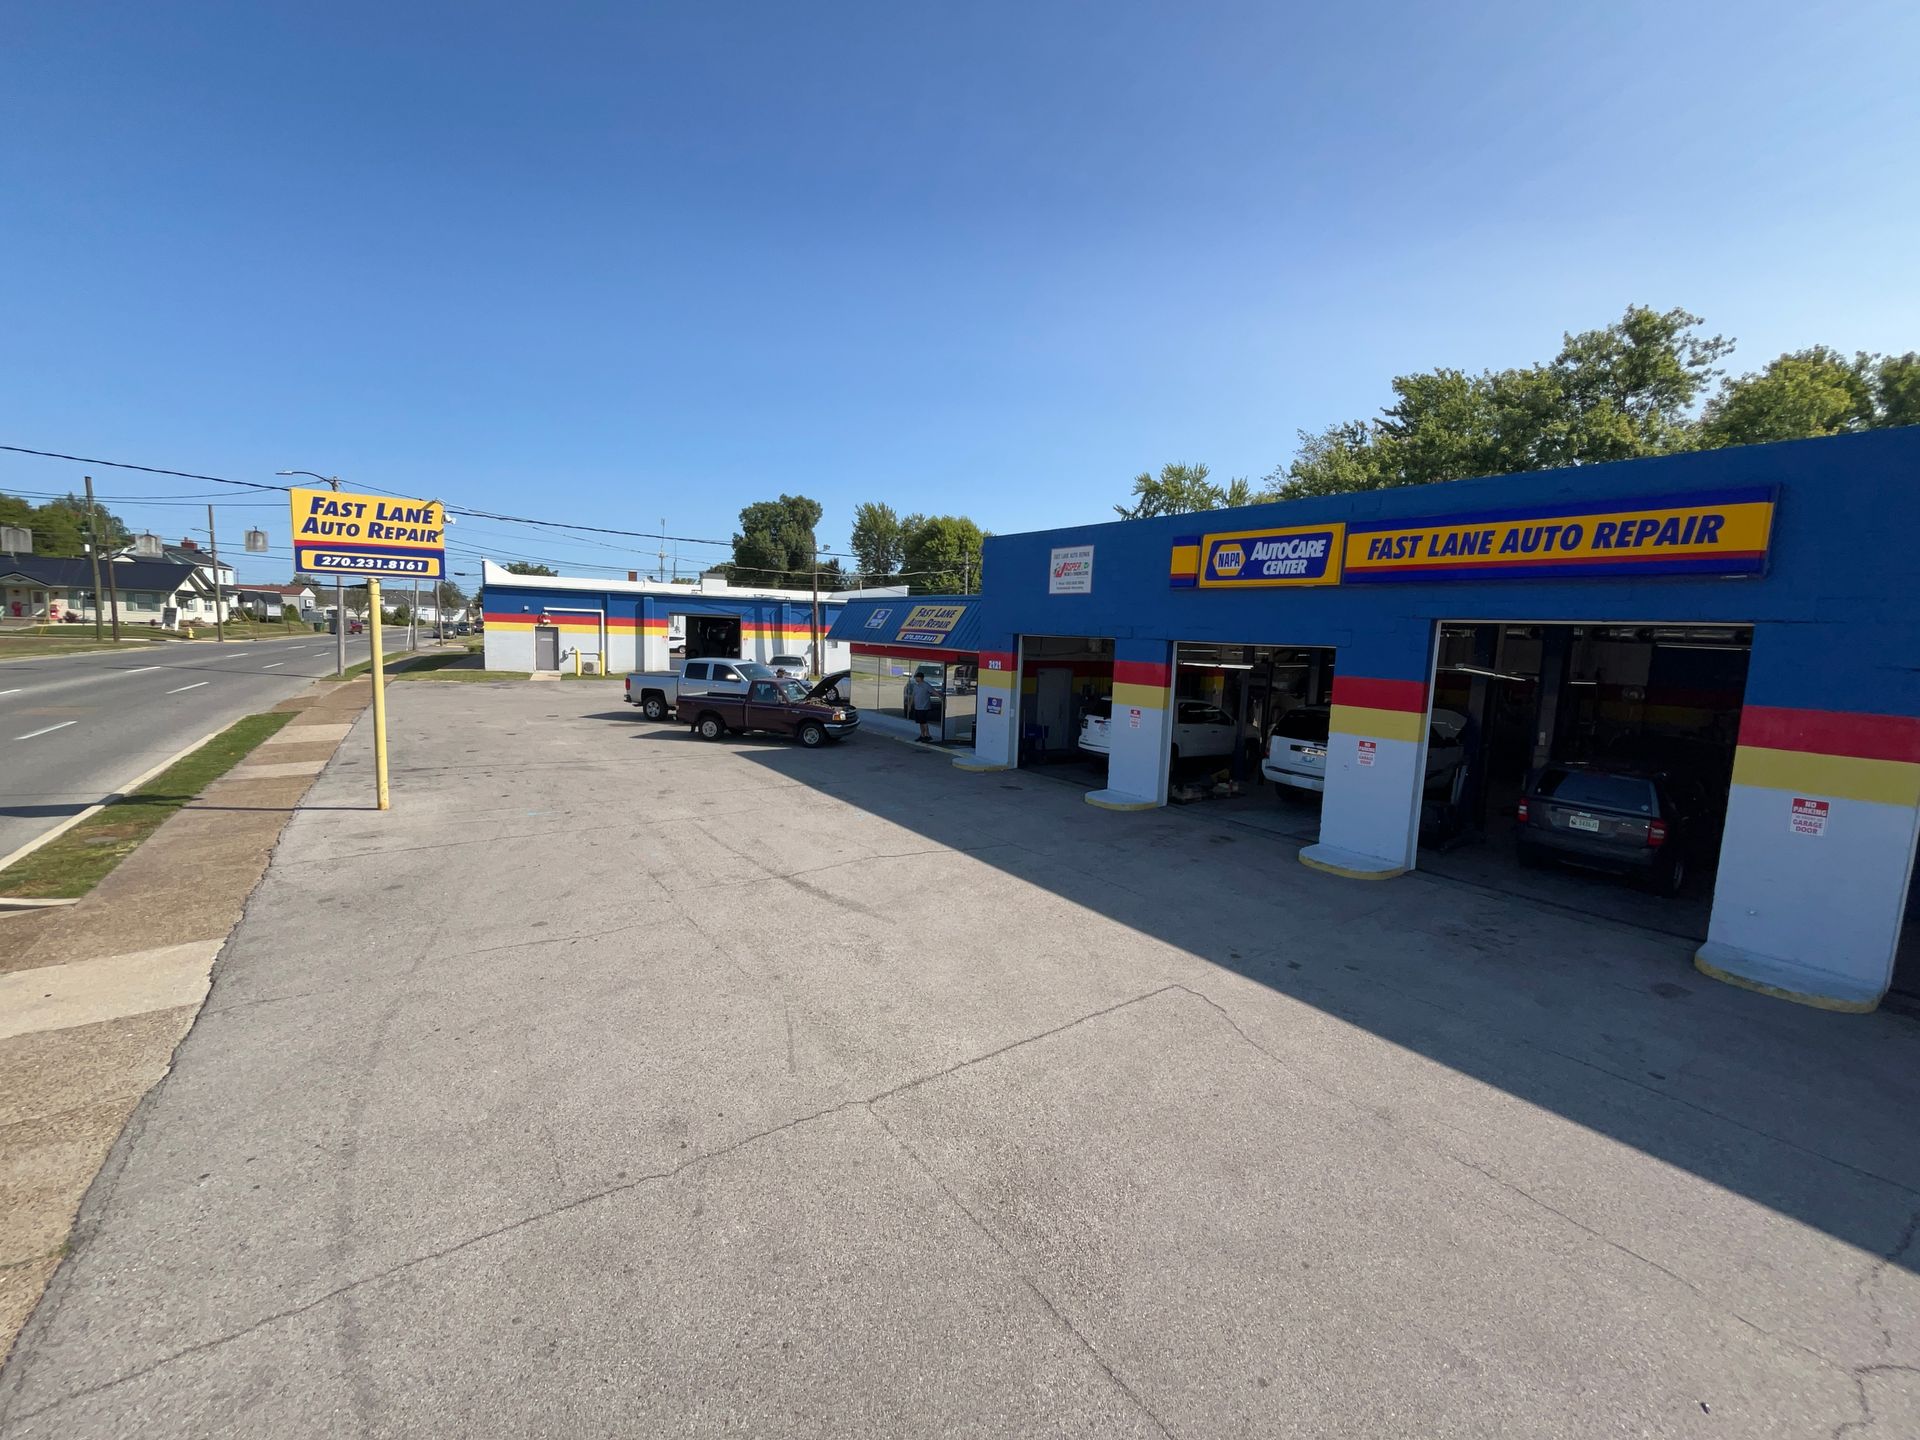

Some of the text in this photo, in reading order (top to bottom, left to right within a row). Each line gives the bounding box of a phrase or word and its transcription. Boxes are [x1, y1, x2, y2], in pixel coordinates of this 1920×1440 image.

[310, 496, 434, 525] FAST LANE
[301, 517, 439, 543] AUTO REPAIR
[1367, 515, 1725, 560] FAST LANE AUTO REPAIR
[321, 556, 423, 571] 270.231.8161
[1217, 552, 1240, 568] NAPA
[1262, 560, 1308, 576] CENTER
[915, 607, 957, 618] FAST LANE
[906, 617, 952, 629] AUTO REPAIR
[1793, 807, 1827, 816] PARKING
[1792, 818, 1823, 829] GARAGE
[1795, 826, 1818, 835] DOOR
